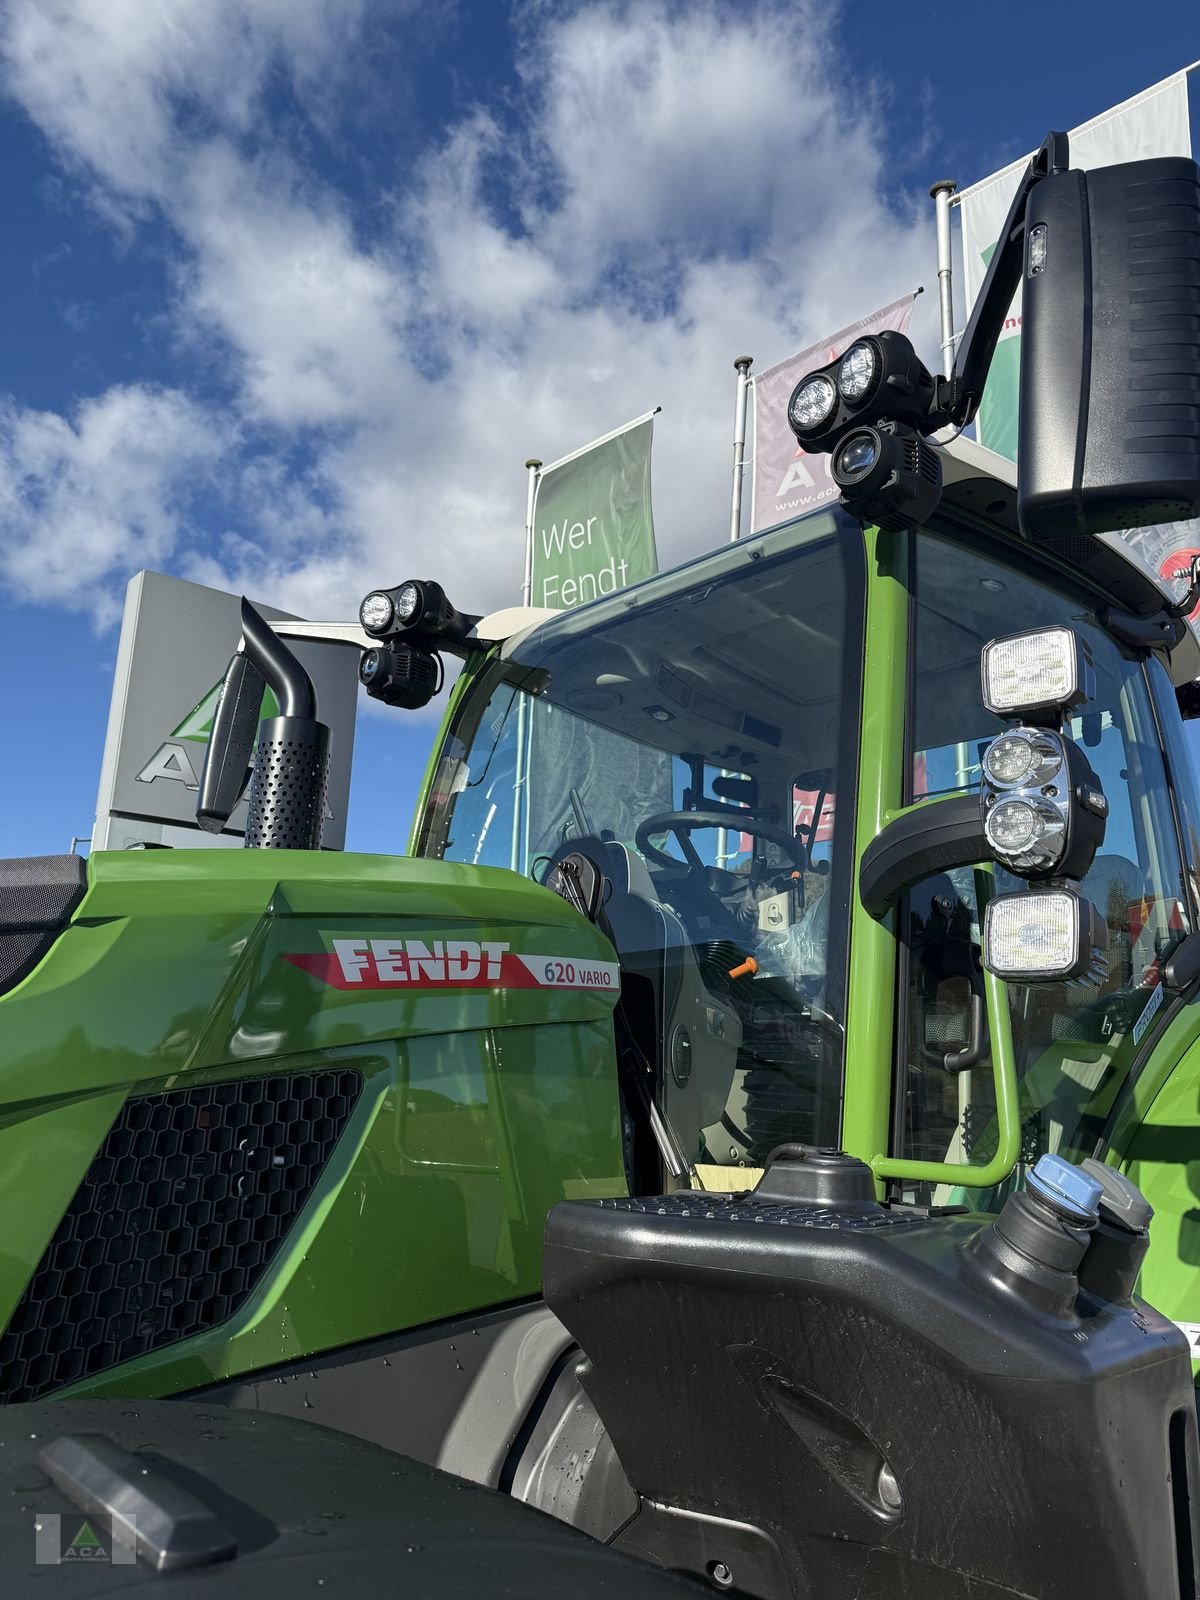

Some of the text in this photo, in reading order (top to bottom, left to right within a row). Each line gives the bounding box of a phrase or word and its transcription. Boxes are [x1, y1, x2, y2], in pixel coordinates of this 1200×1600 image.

[542, 516, 597, 559] Wer
[543, 556, 628, 608] Fendt
[332, 939, 510, 982] FENDT
[544, 962, 611, 985] 620 VARIO
